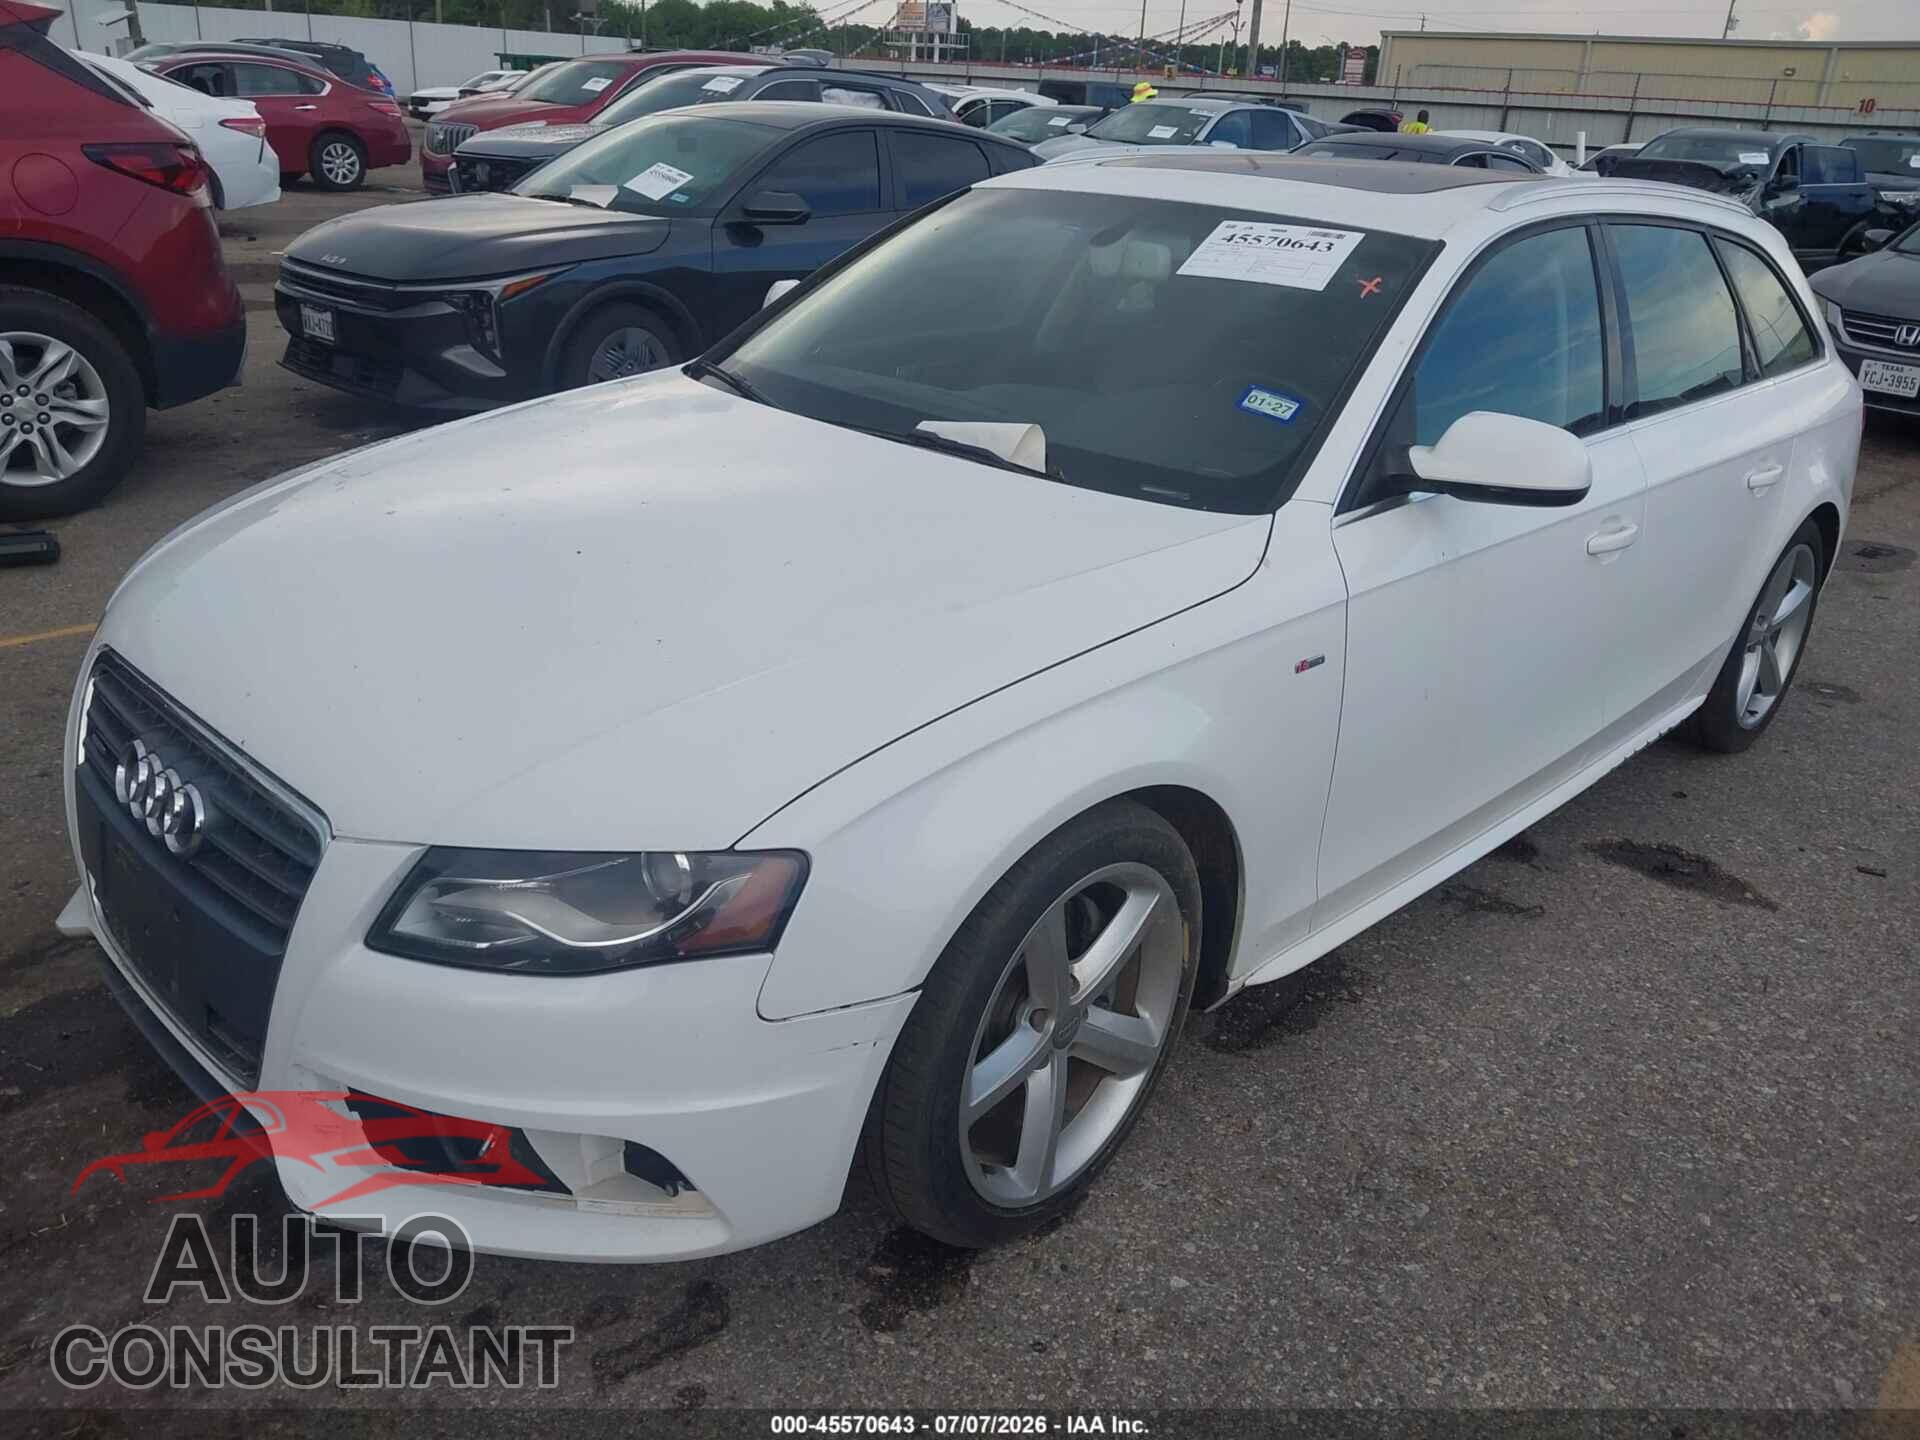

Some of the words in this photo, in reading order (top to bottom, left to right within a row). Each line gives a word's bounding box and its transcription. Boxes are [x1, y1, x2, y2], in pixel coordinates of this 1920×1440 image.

[1858, 98, 1876, 113] 10
[1221, 232, 1336, 253] 45570643
[1881, 363, 1905, 373] TEXAS
